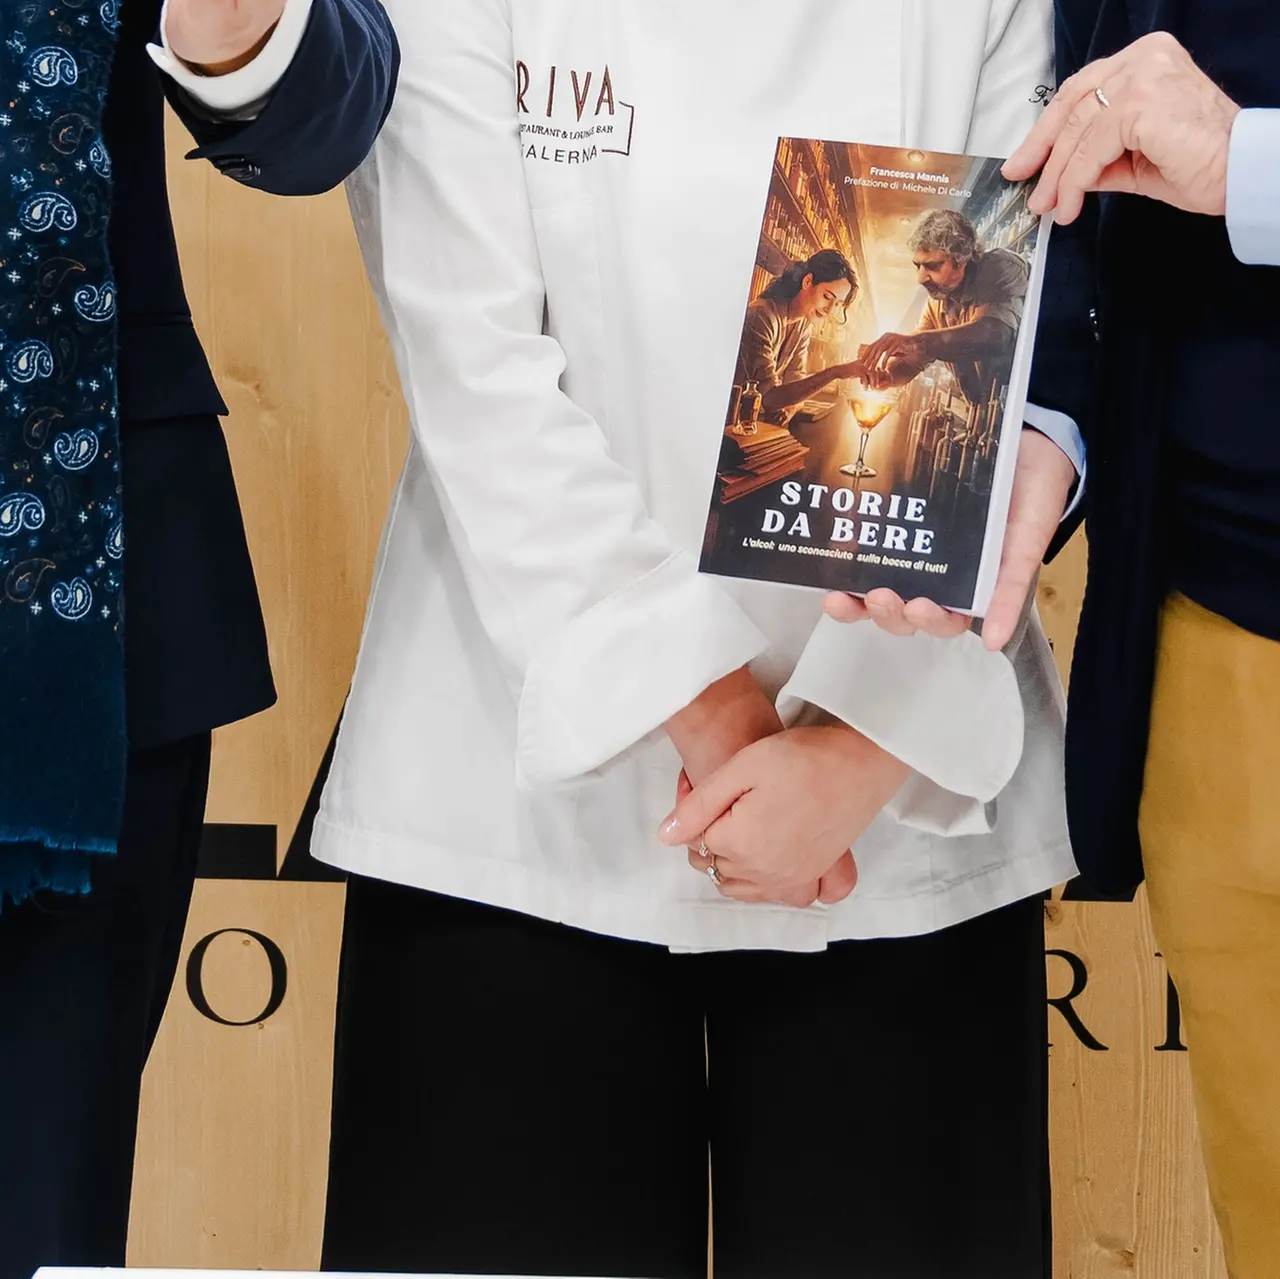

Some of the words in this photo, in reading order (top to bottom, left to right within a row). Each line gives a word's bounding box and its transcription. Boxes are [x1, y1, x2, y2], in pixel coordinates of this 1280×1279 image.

[515, 60, 615, 122] RIVA
[561, 131, 569, 139] &
[595, 124, 614, 135] BAR
[522, 144, 598, 164] ALERNA
[870, 166, 915, 180] Francesca
[844, 176, 888, 189] Prefazione
[890, 180, 899, 189] di
[902, 183, 936, 194] Michele
[937, 186, 948, 195] Di
[948, 188, 972, 198] Carlo
[780, 481, 927, 523] STORIE
[761, 508, 812, 538] DA
[830, 517, 935, 555] BERE
[778, 543, 797, 554] uno
[797, 545, 853, 561] sconosciuto
[856, 553, 881, 565] sulla
[882, 556, 912, 569] bocca
[913, 560, 925, 571] di
[925, 562, 948, 575] tutti
